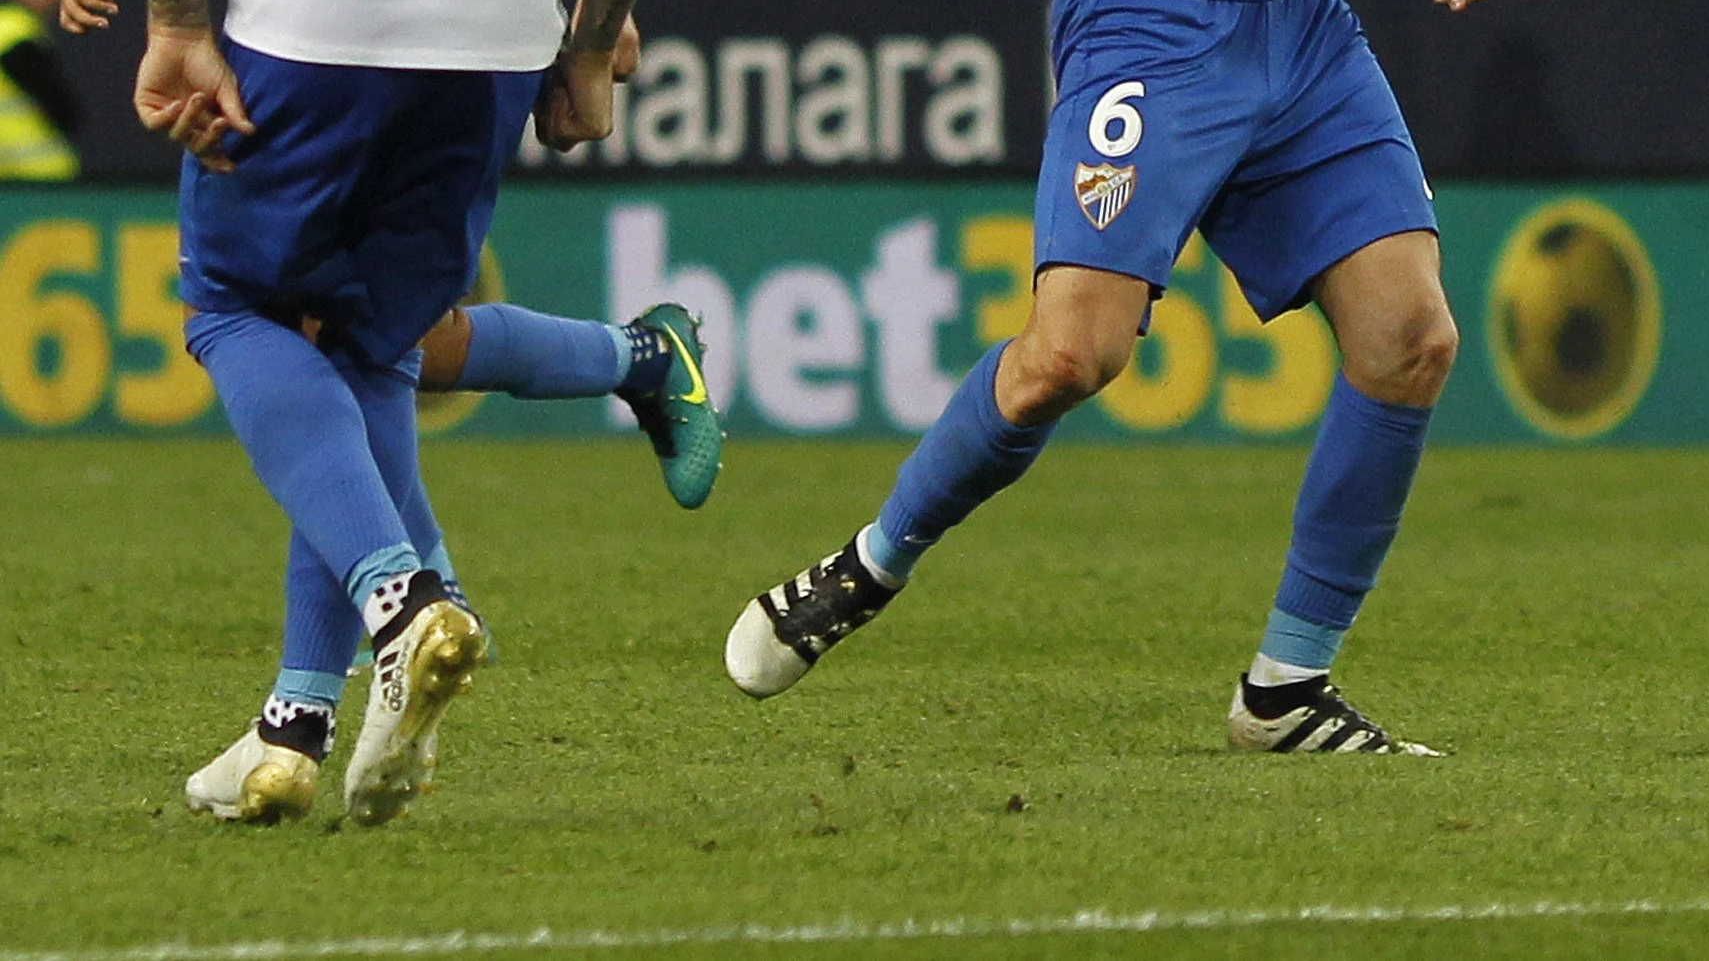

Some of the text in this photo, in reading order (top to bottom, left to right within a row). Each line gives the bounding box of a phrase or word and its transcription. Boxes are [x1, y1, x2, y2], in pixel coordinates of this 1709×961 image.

[519, 37, 1004, 166] алага
[1089, 80, 1146, 158] 6
[0, 218, 222, 428] 65
